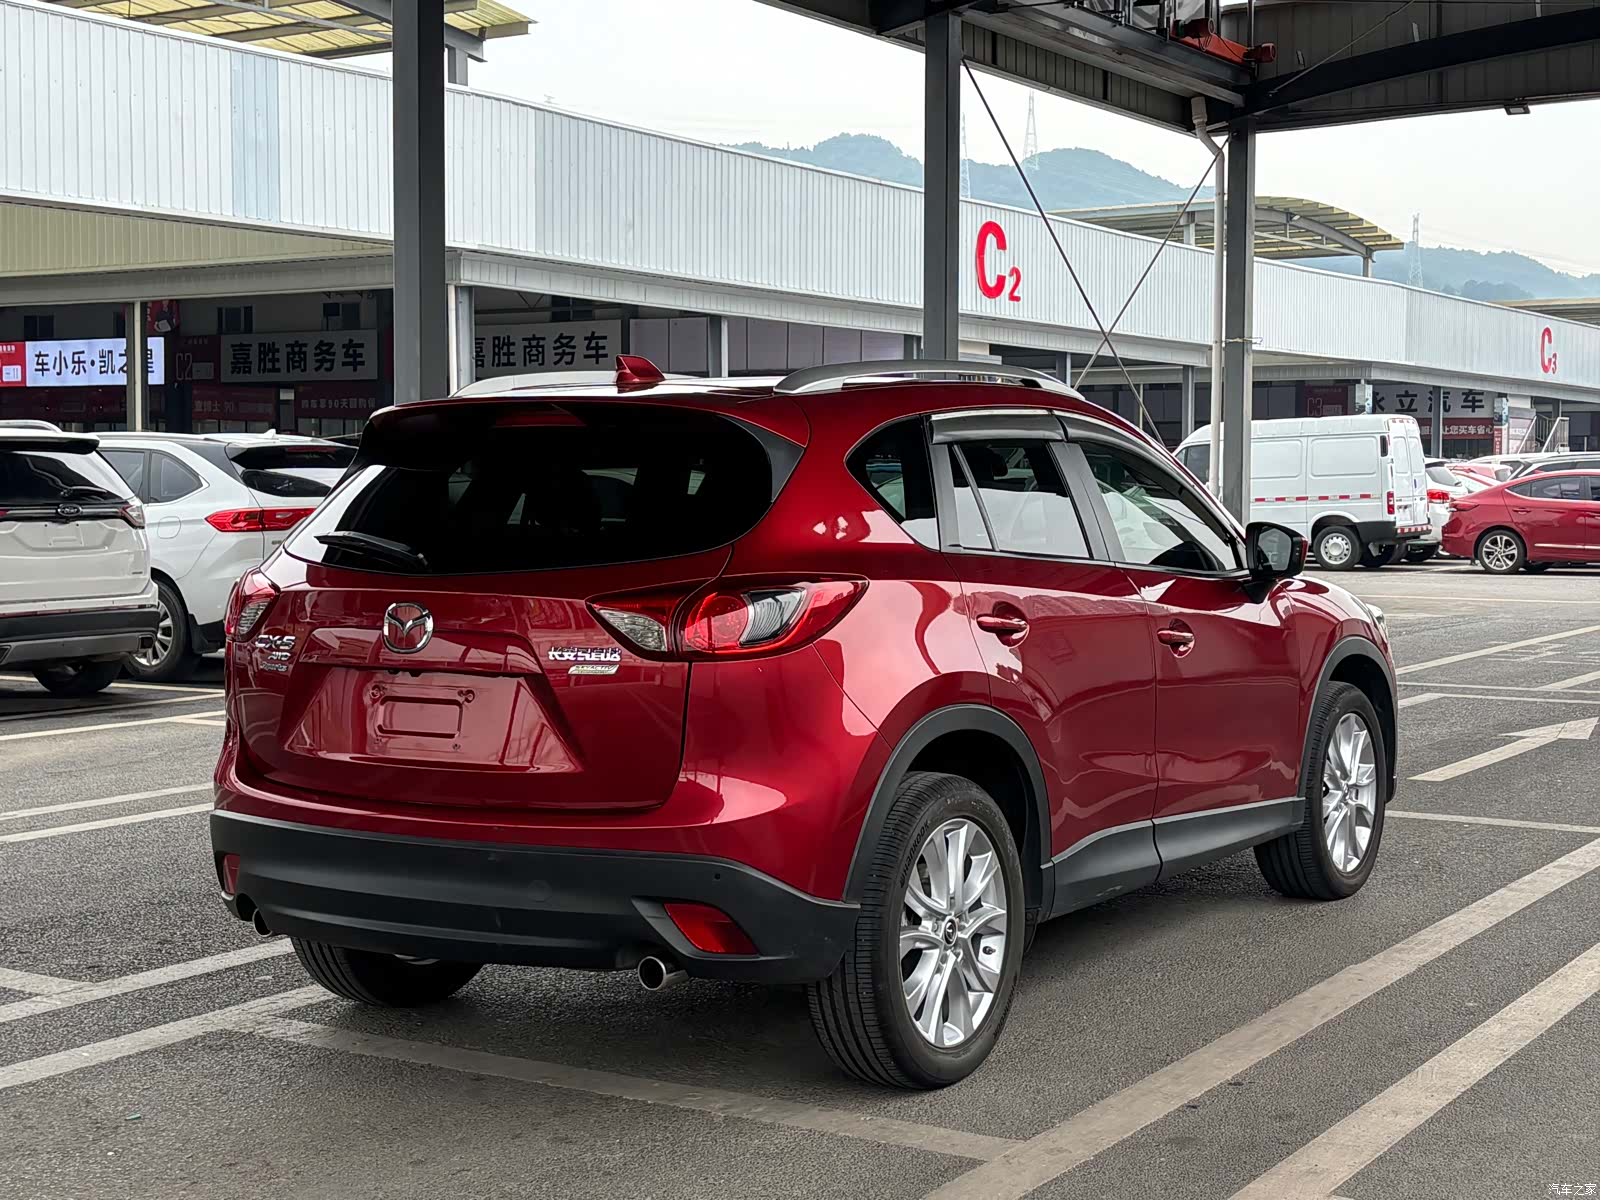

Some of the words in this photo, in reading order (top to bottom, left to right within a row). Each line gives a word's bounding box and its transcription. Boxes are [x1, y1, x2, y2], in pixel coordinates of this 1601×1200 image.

[976, 220, 1022, 303] C2
[230, 339, 366, 375] 嘉胜商务车
[1541, 327, 1557, 374] C3
[255, 634, 296, 650] CX-5
